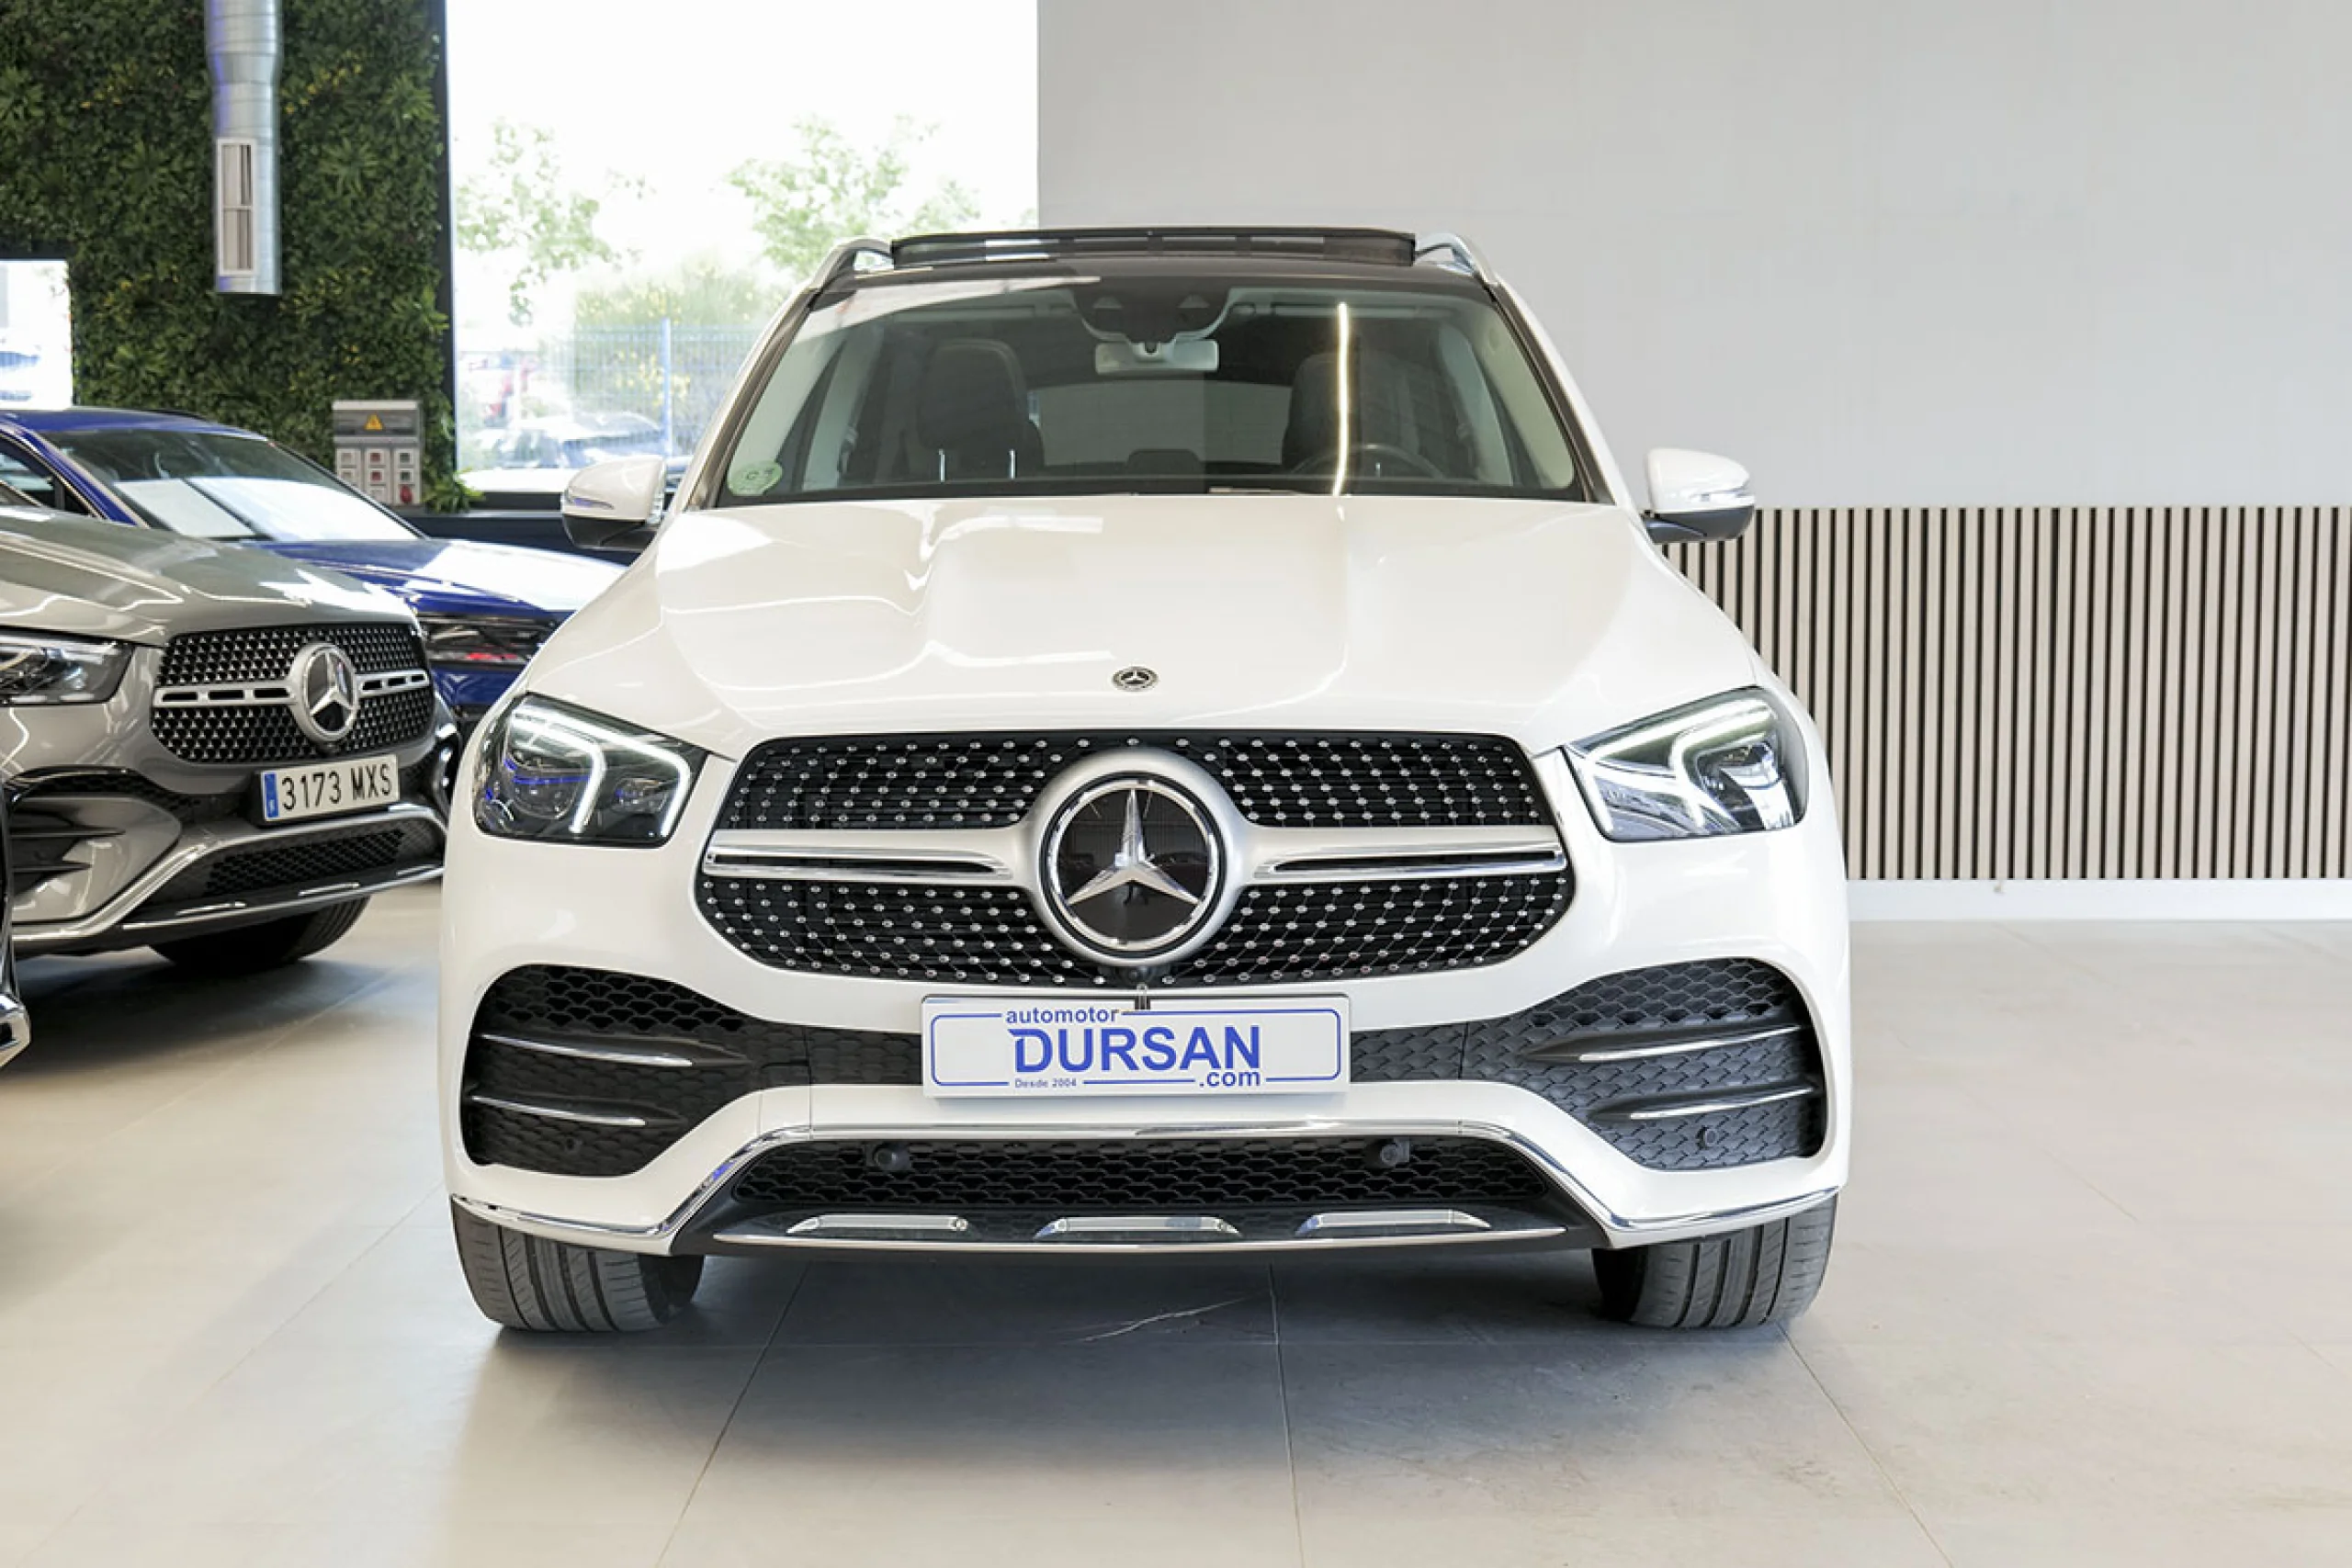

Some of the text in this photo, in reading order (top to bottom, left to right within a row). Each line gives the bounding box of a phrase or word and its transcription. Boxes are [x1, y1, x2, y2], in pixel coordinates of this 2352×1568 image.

[281, 763, 392, 810] 3173 MXS
[1006, 1008, 1119, 1024] automotor
[1008, 1025, 1260, 1073] DURSAN
[1014, 1077, 1077, 1089] Desde 2004
[1199, 1072, 1261, 1088] .com
